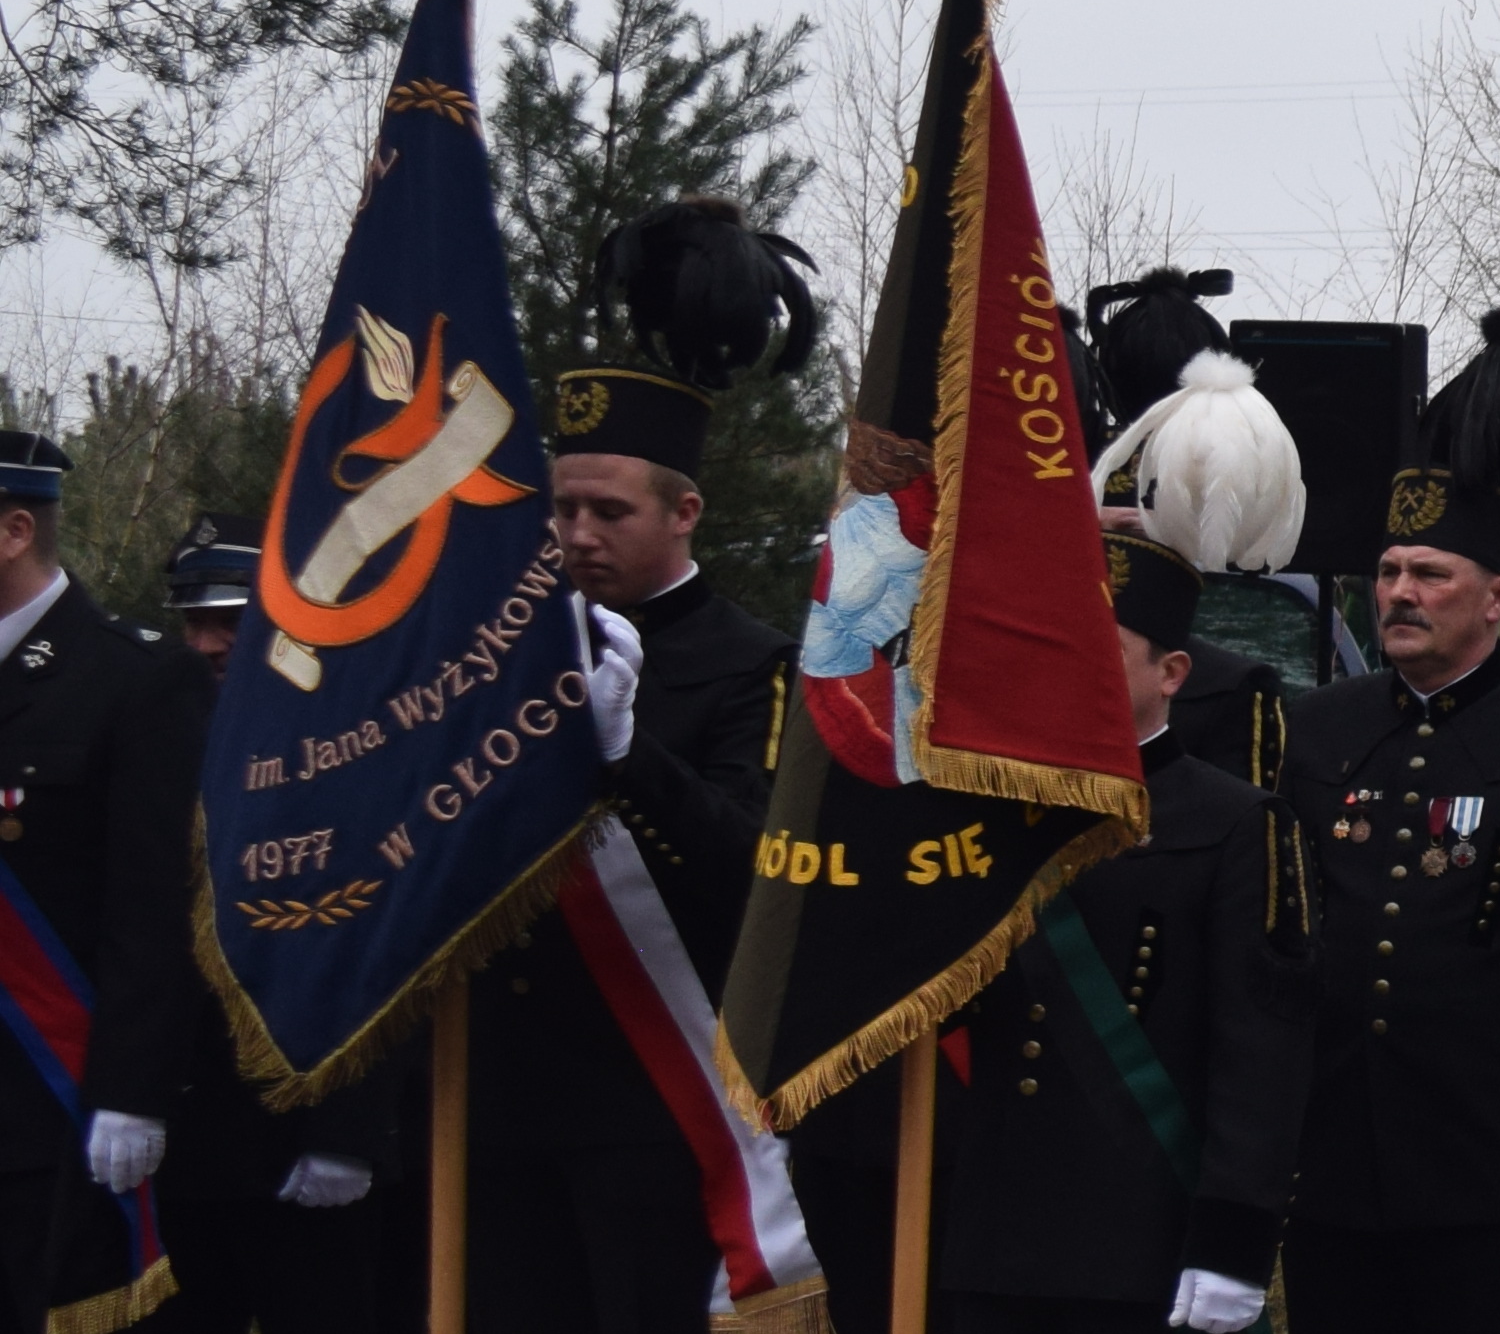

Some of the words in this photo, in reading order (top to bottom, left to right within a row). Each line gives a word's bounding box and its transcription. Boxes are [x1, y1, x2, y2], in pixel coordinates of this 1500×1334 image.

[245, 754, 291, 791] im.
[298, 719, 388, 781] Jana
[240, 827, 335, 882] 1977
[905, 821, 994, 886] SIĘ
